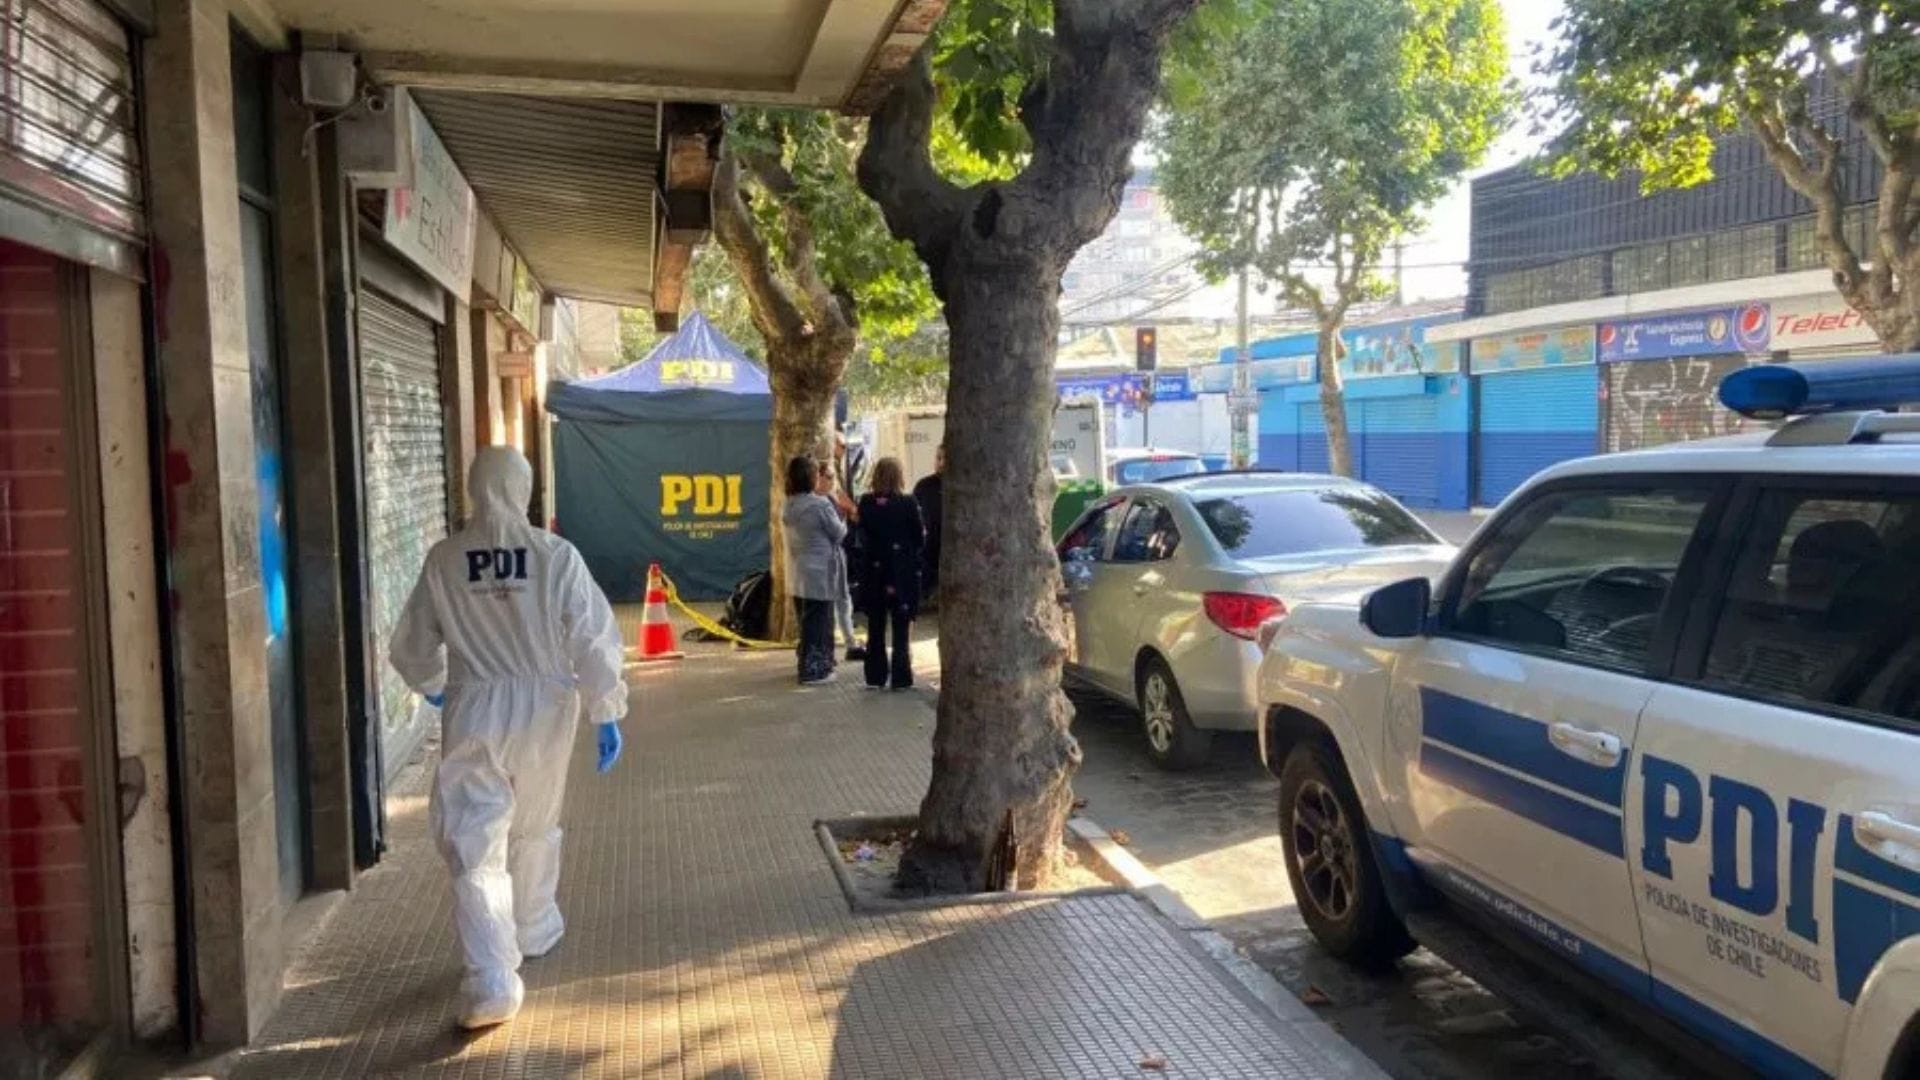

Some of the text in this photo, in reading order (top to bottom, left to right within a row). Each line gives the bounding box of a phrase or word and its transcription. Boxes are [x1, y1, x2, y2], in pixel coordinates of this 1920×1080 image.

[661, 360, 735, 384] PDI
[660, 474, 742, 515] PDI
[466, 547, 528, 582] PDI
[1640, 753, 1827, 944] PDI
[1691, 902, 1711, 929] DE
[1712, 913, 1823, 984] INVESTIGACIONES
[1706, 934, 1766, 979] DE CHILE
